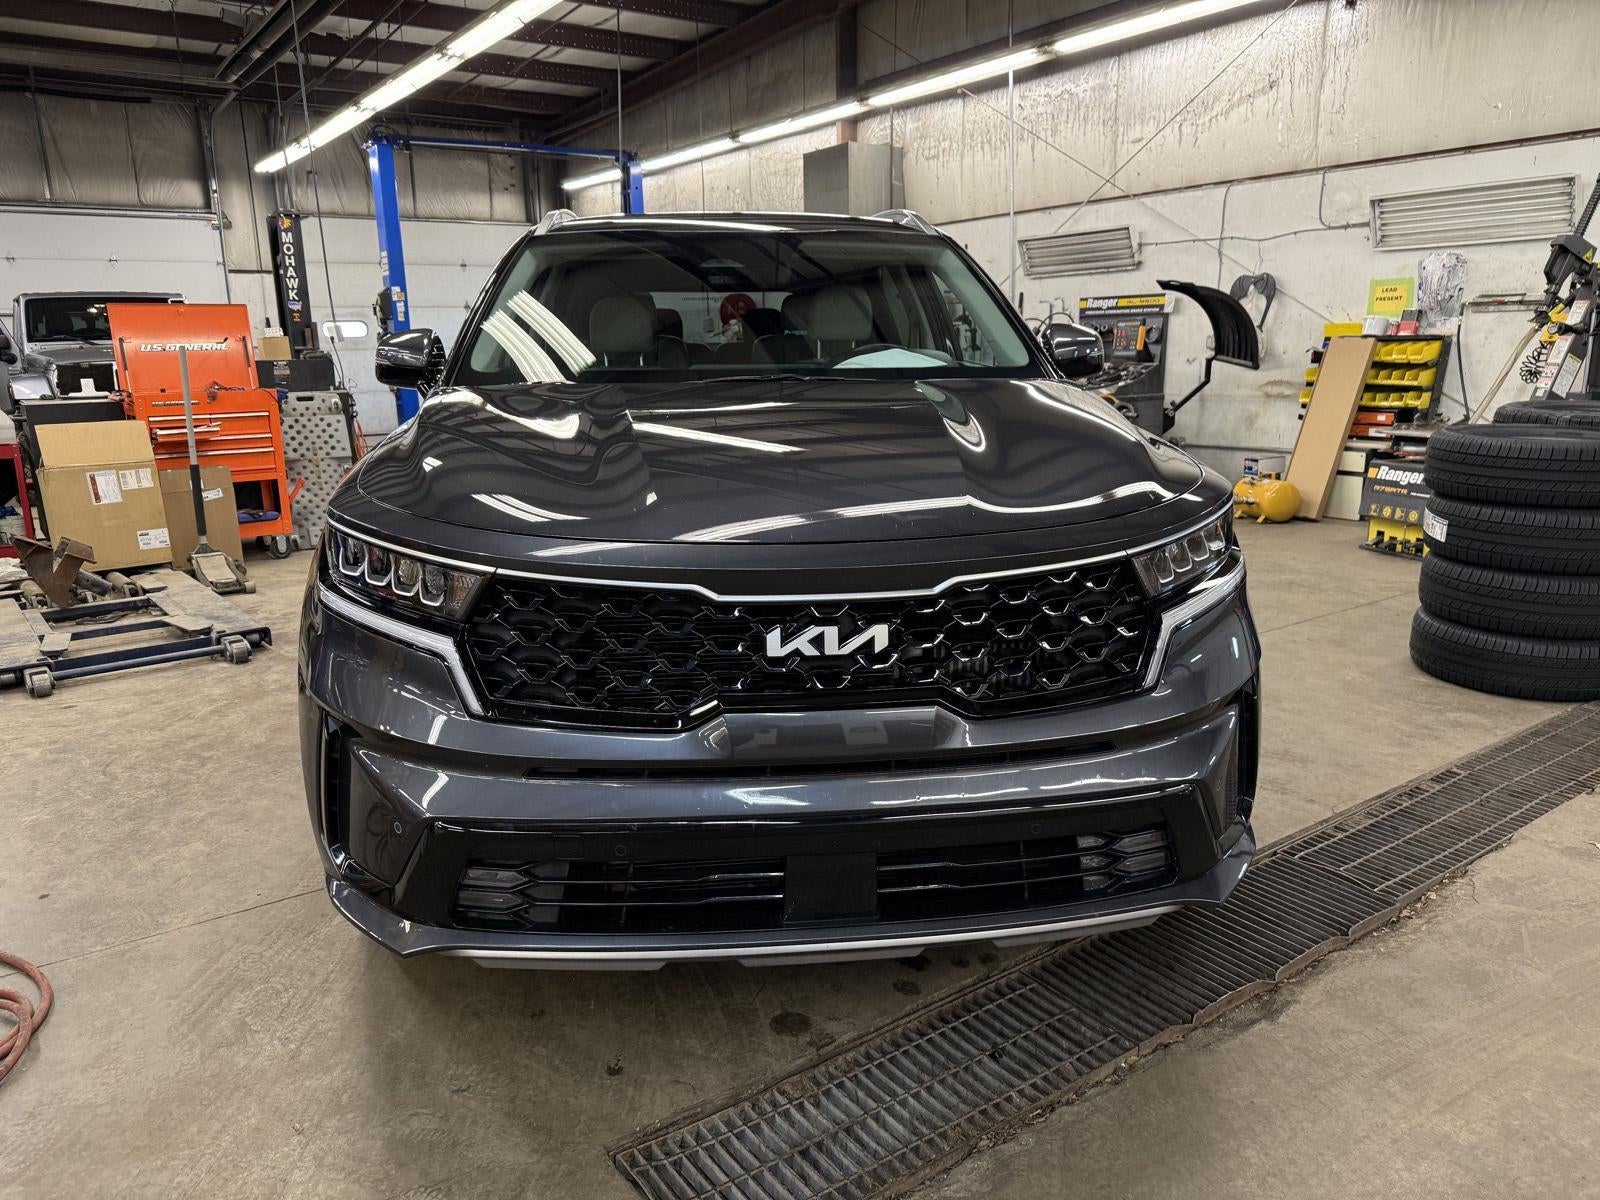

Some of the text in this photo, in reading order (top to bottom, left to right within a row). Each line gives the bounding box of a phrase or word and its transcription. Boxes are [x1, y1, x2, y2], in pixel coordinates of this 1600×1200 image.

[281, 231, 299, 300] MOHAWK
[1086, 298, 1118, 309] Ranger
[1376, 465, 1425, 485] Ranger
[766, 624, 889, 657] KIA
